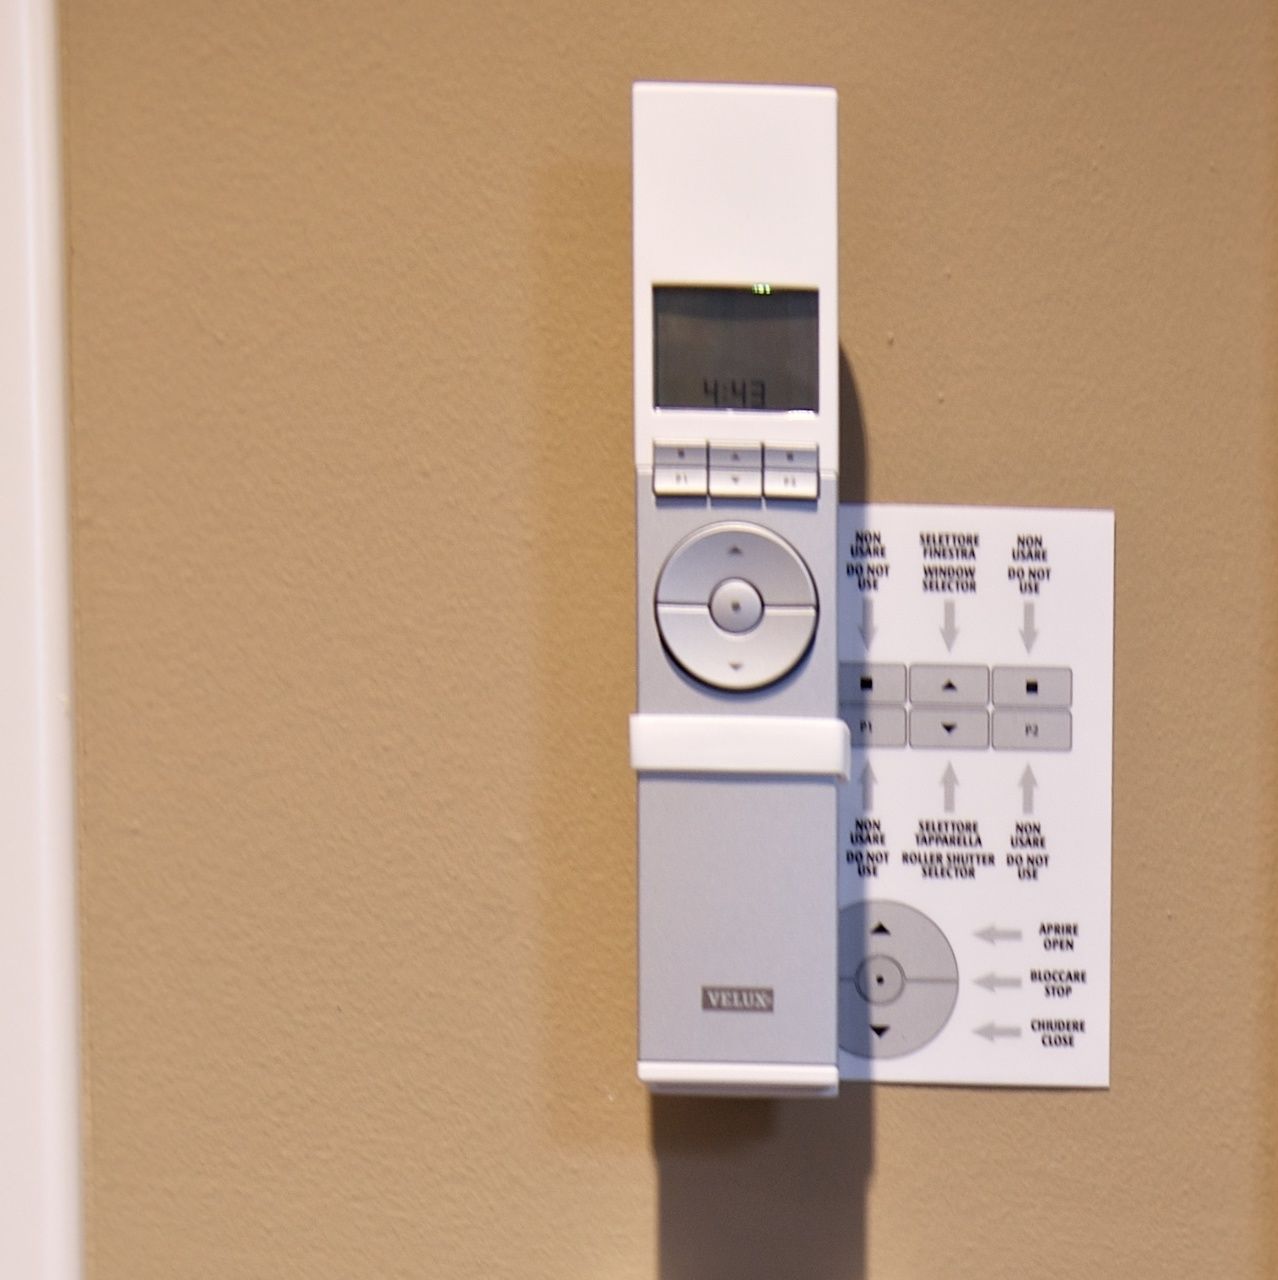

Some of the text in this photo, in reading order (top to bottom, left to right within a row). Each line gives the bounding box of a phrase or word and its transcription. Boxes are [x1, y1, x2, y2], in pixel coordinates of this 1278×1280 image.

[855, 531, 881, 545] NON
[919, 533, 979, 547] SELETTORE
[1017, 535, 1043, 548] NON
[850, 546, 886, 558] USARE
[923, 548, 976, 561] FINESTRA
[1012, 549, 1047, 562] USARE
[846, 563, 890, 577] DO NOT
[923, 565, 976, 579] WINDOW
[1008, 567, 1051, 582] DO NOT
[858, 578, 879, 592] USE
[922, 579, 977, 594] SELECTOR
[1019, 581, 1040, 595] USE
[860, 721, 873, 735] P1
[1025, 723, 1039, 737] P2
[855, 819, 881, 832] NON
[918, 820, 978, 834] SELETTORE
[1015, 822, 1041, 835] NON
[850, 832, 885, 846] USARE
[915, 834, 982, 848] TAPPARELLA
[1010, 836, 1046, 849] USARE
[846, 851, 890, 865] DO NOT
[902, 852, 995, 867] ROLLER SHUTTER
[1006, 854, 1049, 868] DO NOT
[858, 865, 878, 878] USE
[922, 866, 975, 880] SELECTOR
[1018, 868, 1038, 881] USE
[1039, 922, 1079, 936] APRIRE
[1043, 938, 1074, 951] OPEN
[1030, 969, 1087, 984] BLOCCARE
[1044, 985, 1073, 998] STOP
[706, 991, 768, 1008] VELUX
[1030, 1018, 1086, 1033] CHIUDERE
[1041, 1035, 1075, 1048] CLOSE
